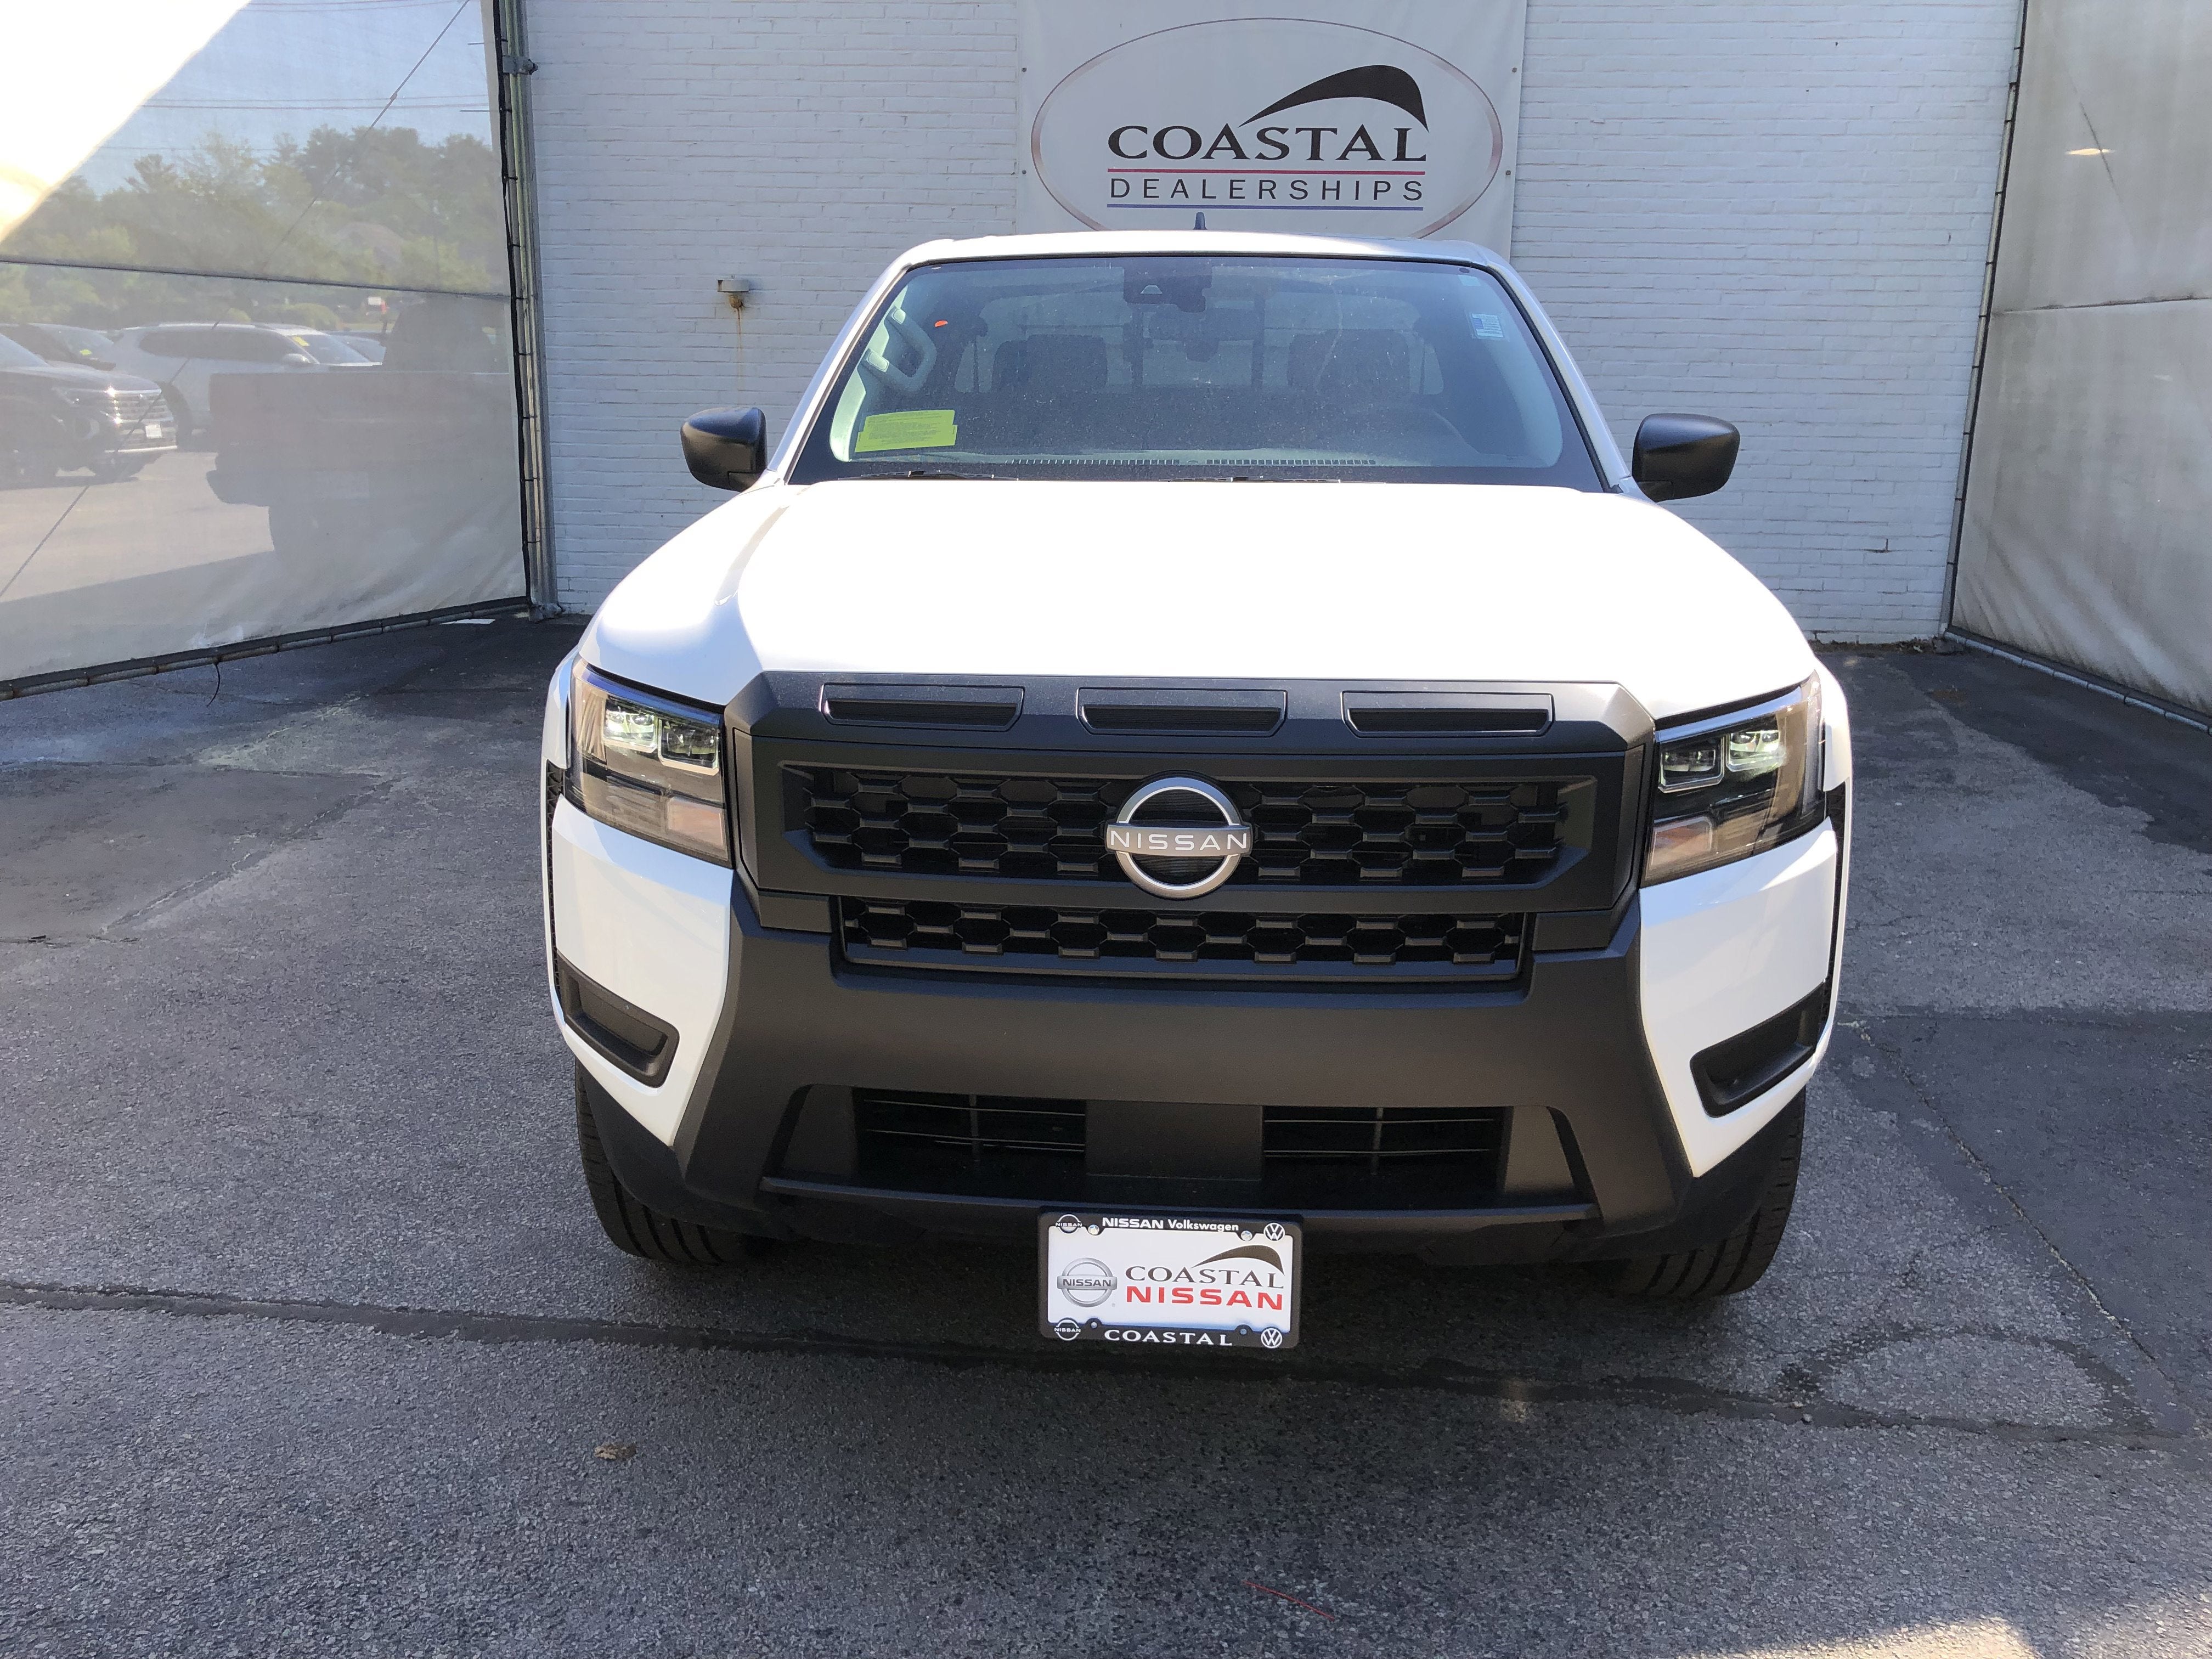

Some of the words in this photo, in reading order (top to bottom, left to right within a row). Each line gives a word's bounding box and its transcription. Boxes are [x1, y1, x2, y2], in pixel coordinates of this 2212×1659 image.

[1108, 123, 1426, 161] COASTAL
[1110, 177, 1423, 201] DEALERSHIPS
[1110, 830, 1247, 851] NISSAN
[1102, 1217, 1164, 1229] NISSAN
[1167, 1218, 1239, 1232] Volkswagen
[1062, 1278, 1112, 1288] NISSAN
[1125, 1266, 1284, 1289] COASTAL
[1126, 1286, 1283, 1310] NISSAN
[1104, 1329, 1233, 1346] COASTAL
